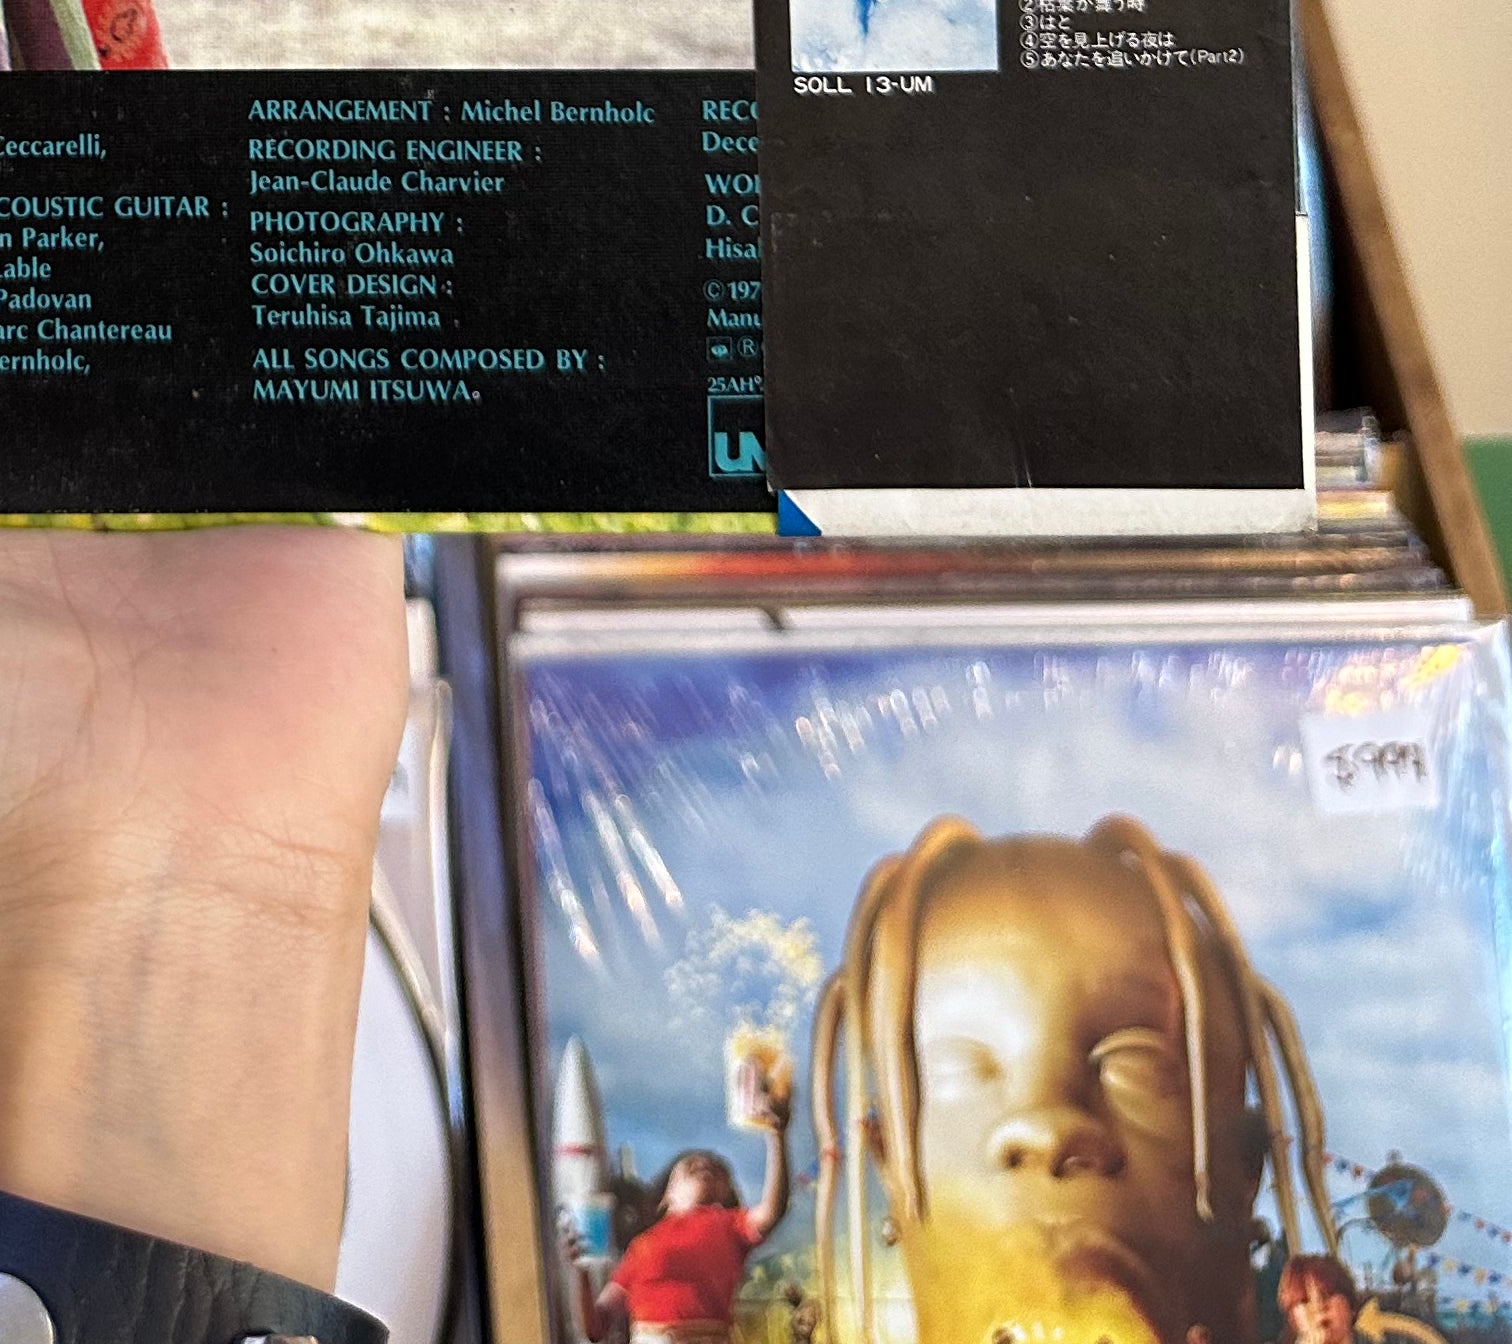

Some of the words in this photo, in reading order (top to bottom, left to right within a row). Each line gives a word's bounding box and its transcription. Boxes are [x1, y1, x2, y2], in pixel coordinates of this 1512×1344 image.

[793, 76, 853, 95] SOLL
[866, 75, 933, 94] 13-UM
[248, 96, 432, 121] ARRANGEMENT
[461, 99, 541, 122] Michel
[550, 100, 655, 124] Bernholc
[249, 138, 396, 161] RECORDING
[406, 139, 523, 162] ENGINEER
[250, 168, 392, 195] Jean-Claude
[401, 169, 505, 193] Charvier
[114, 196, 210, 217] GUITAR
[252, 348, 295, 370] ALL
[304, 348, 390, 370] SONGS
[400, 348, 545, 370] COMPOSED
[556, 349, 587, 370] BY
[253, 379, 359, 401] MAYUMI
